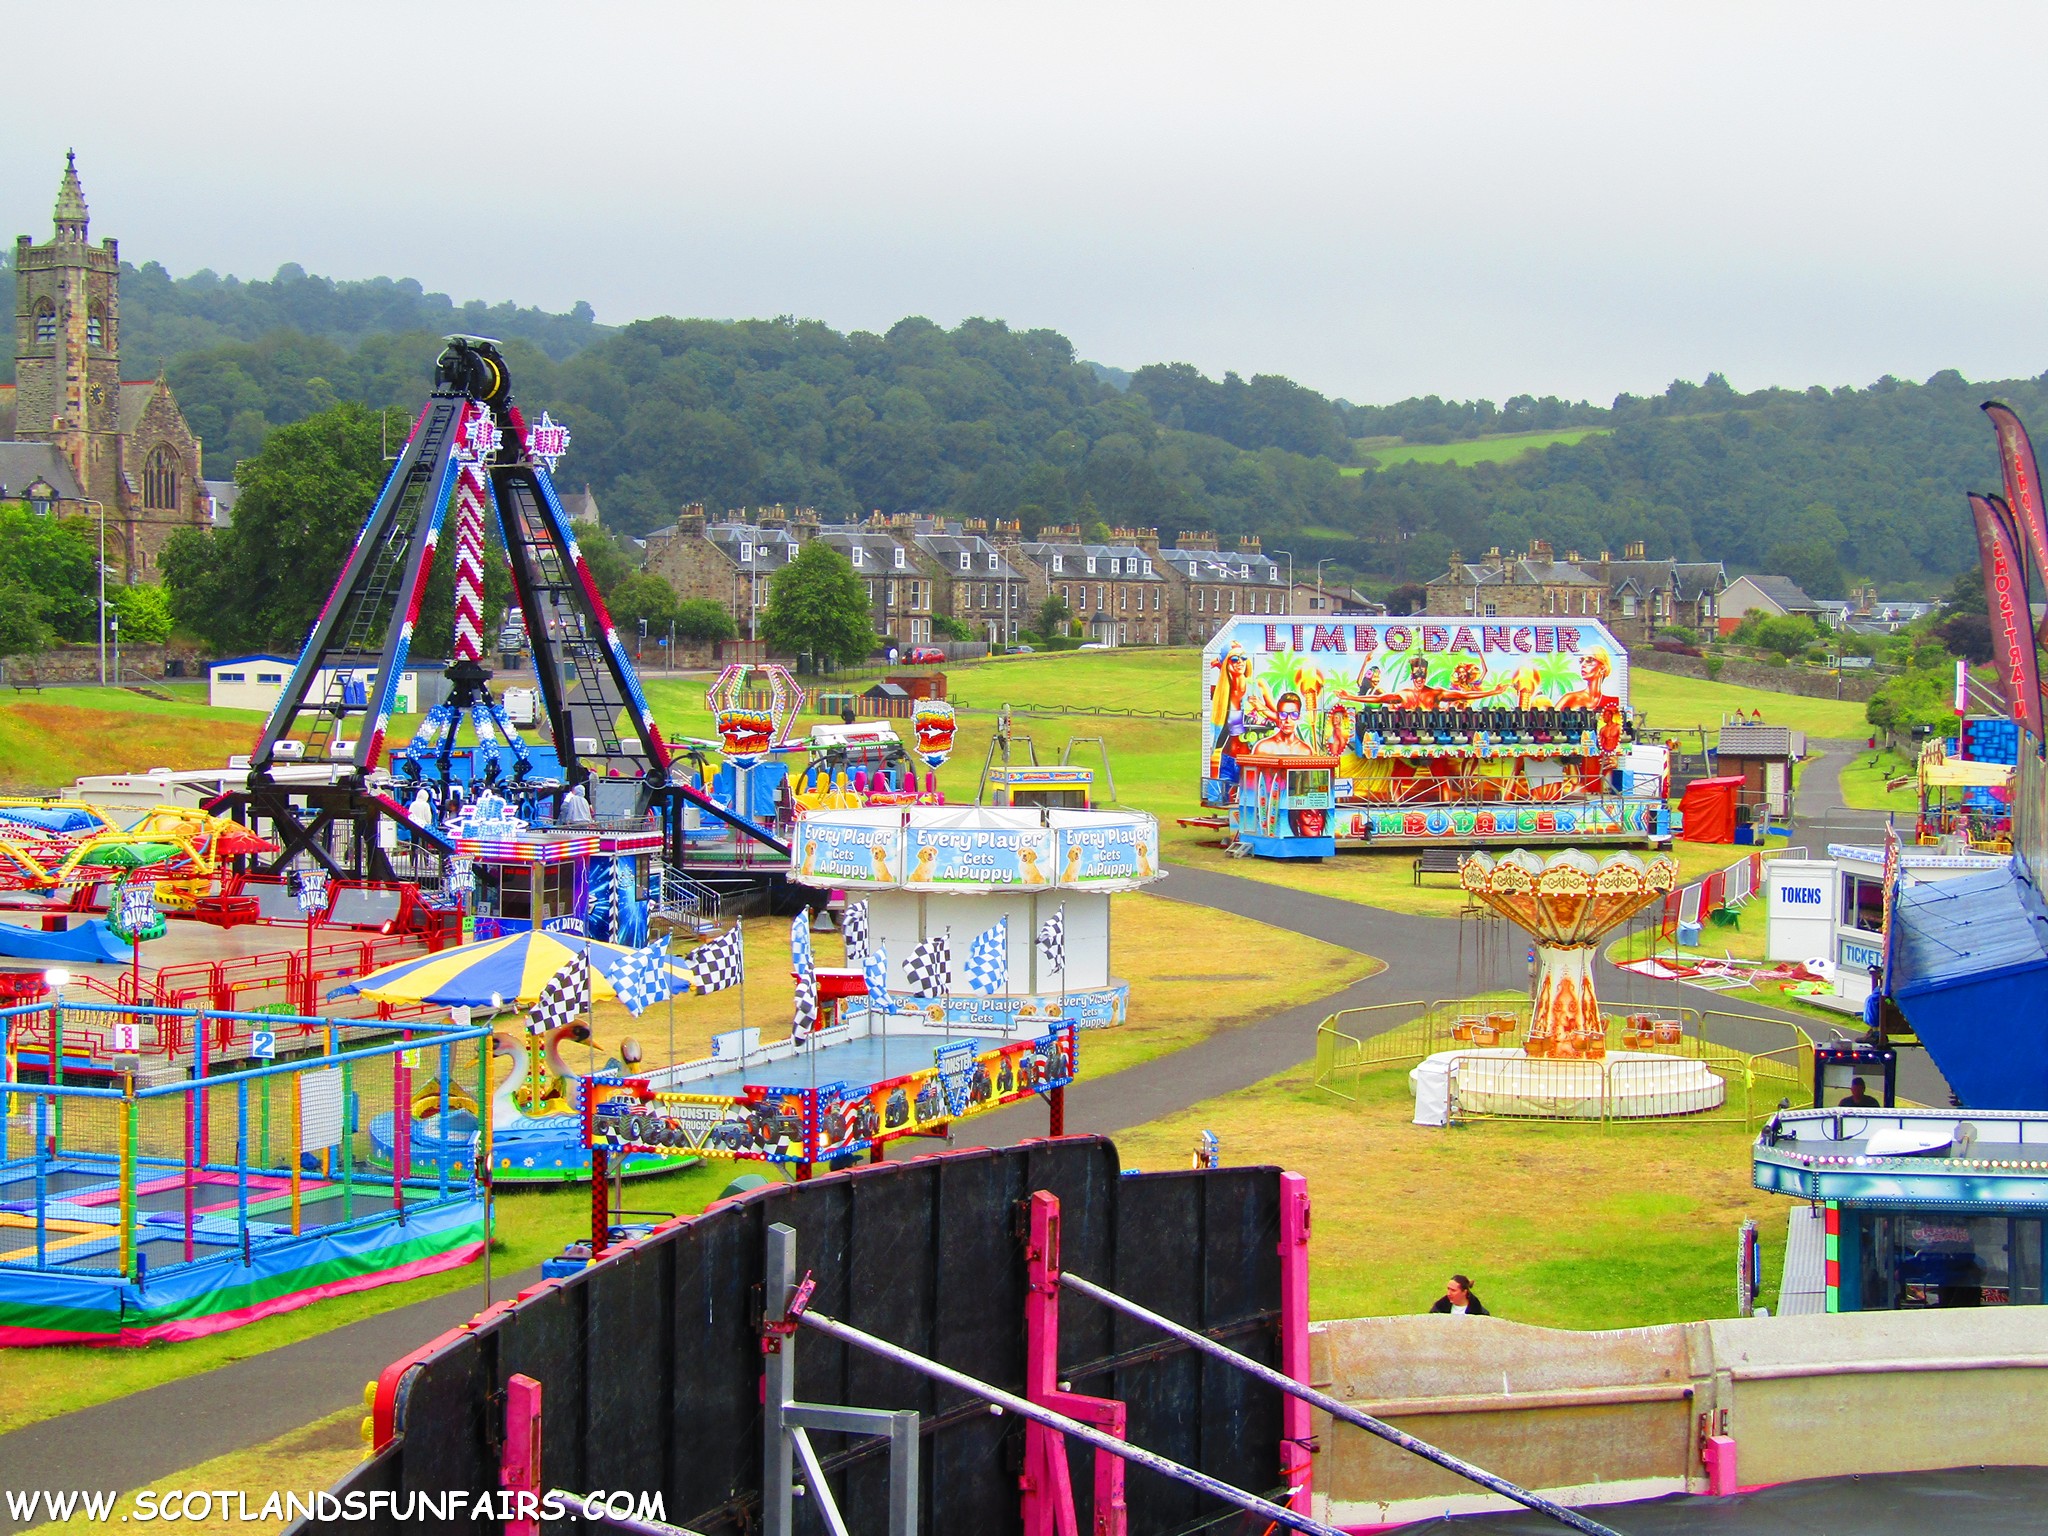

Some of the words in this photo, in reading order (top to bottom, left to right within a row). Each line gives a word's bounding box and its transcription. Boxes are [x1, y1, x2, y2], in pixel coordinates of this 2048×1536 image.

[1264, 624, 1413, 653] LIMBO
[1424, 624, 1581, 653] DANCER
[1453, 810, 1578, 835] DANCER
[805, 824, 841, 847] Every
[843, 828, 891, 849] Player
[917, 829, 972, 852] Every
[977, 832, 1042, 852] Player
[1066, 829, 1105, 849] Every
[1108, 827, 1150, 847] Player
[832, 847, 855, 861] Gets
[963, 852, 994, 865] Gets
[1099, 849, 1121, 862] Gets
[454, 860, 470, 874] SKY
[820, 860, 827, 873] A
[829, 861, 868, 880] Puppy
[943, 865, 955, 879] A
[958, 865, 1013, 884] Puppy
[1086, 863, 1094, 877] A
[1096, 863, 1133, 878] Puppy
[304, 875, 323, 891] SKY
[451, 873, 475, 890] DIVER
[129, 890, 149, 907] SKY
[300, 891, 327, 909] DIVER
[1781, 886, 1821, 904] TOKENS
[124, 907, 155, 927] DIVER
[546, 919, 561, 932] SKY
[562, 917, 585, 935] DIVER
[1846, 945, 1884, 966] TICKET
[940, 998, 980, 1013] Every
[982, 999, 1028, 1013] Player
[1057, 995, 1088, 1008] Every
[1089, 991, 1116, 1006] Player
[970, 1013, 993, 1023] Gets
[1082, 1008, 1098, 1017] Gets
[1080, 1018, 1106, 1029] Puppy
[121, 1026, 132, 1048] 1
[255, 1032, 274, 1056] 2
[670, 1106, 723, 1121] MONSTER
[681, 1119, 712, 1131] TRUCKS
